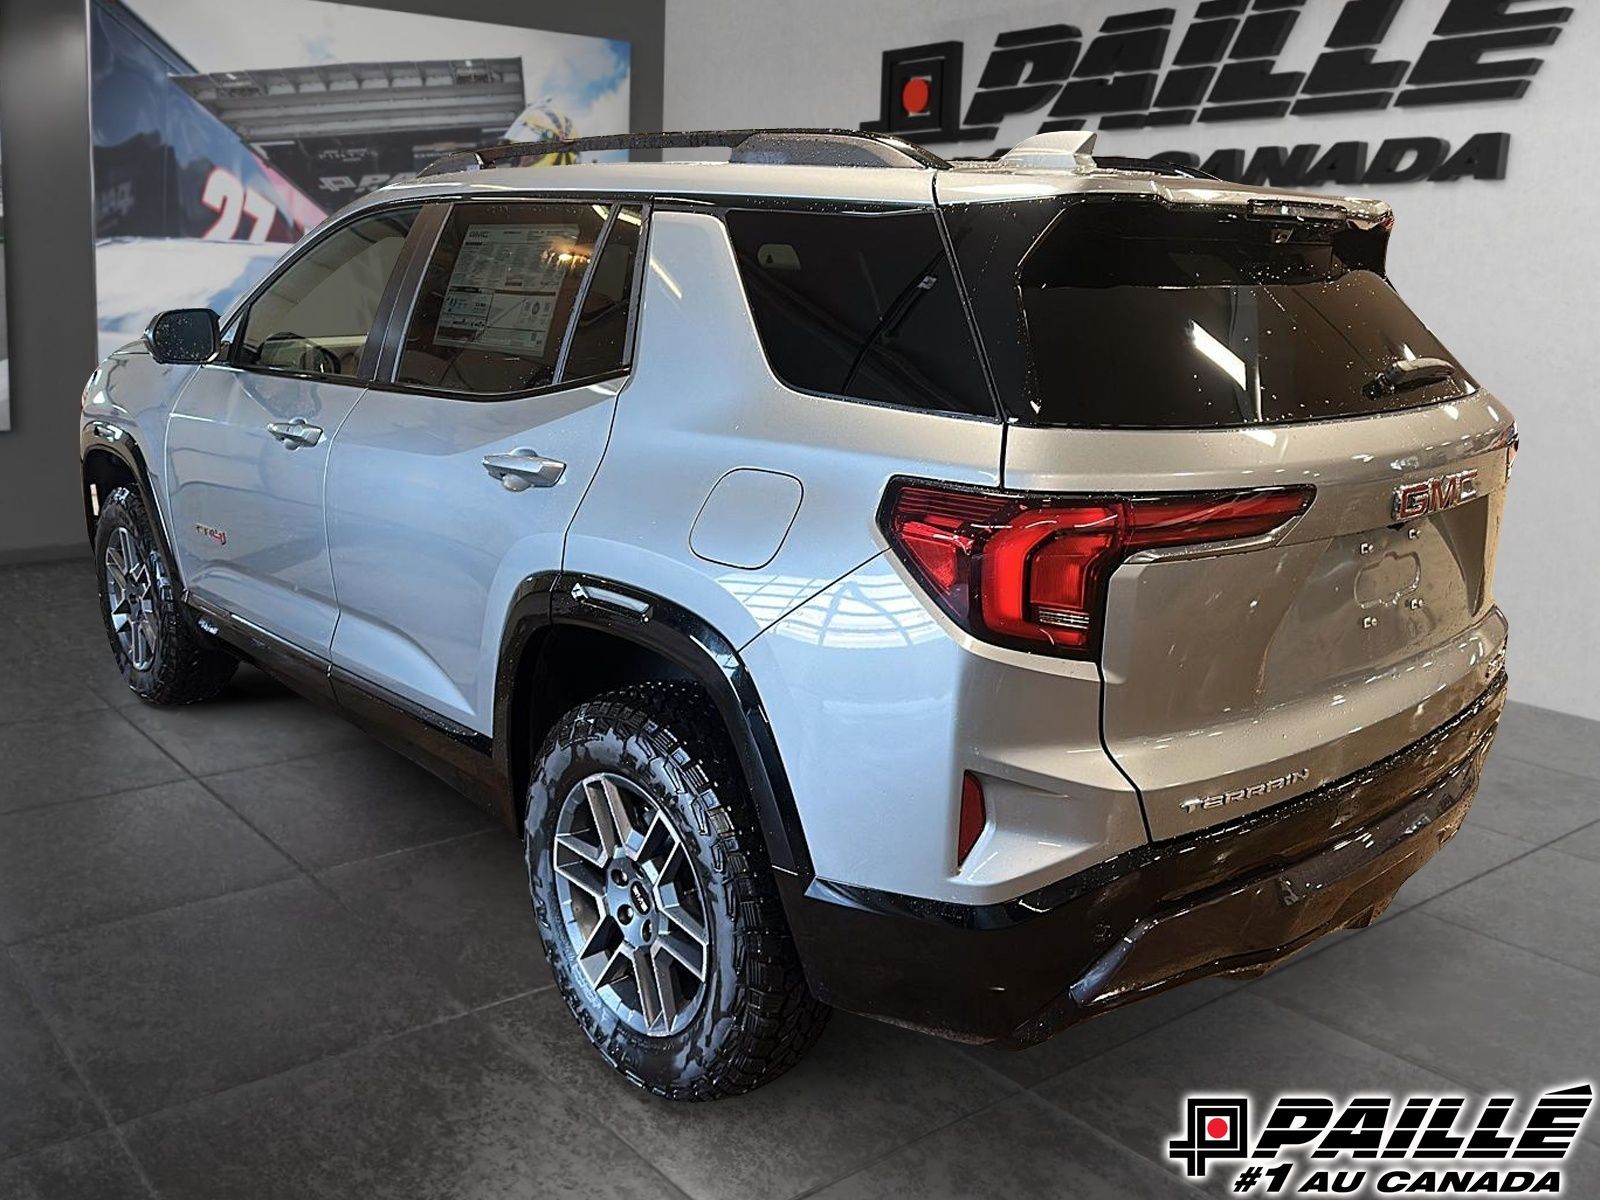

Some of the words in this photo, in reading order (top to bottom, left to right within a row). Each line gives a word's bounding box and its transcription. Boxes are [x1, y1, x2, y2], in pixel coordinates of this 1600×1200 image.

[200, 166, 277, 243] 27
[1391, 469, 1478, 521] GMC
[1179, 768, 1309, 813] TERRAIN
